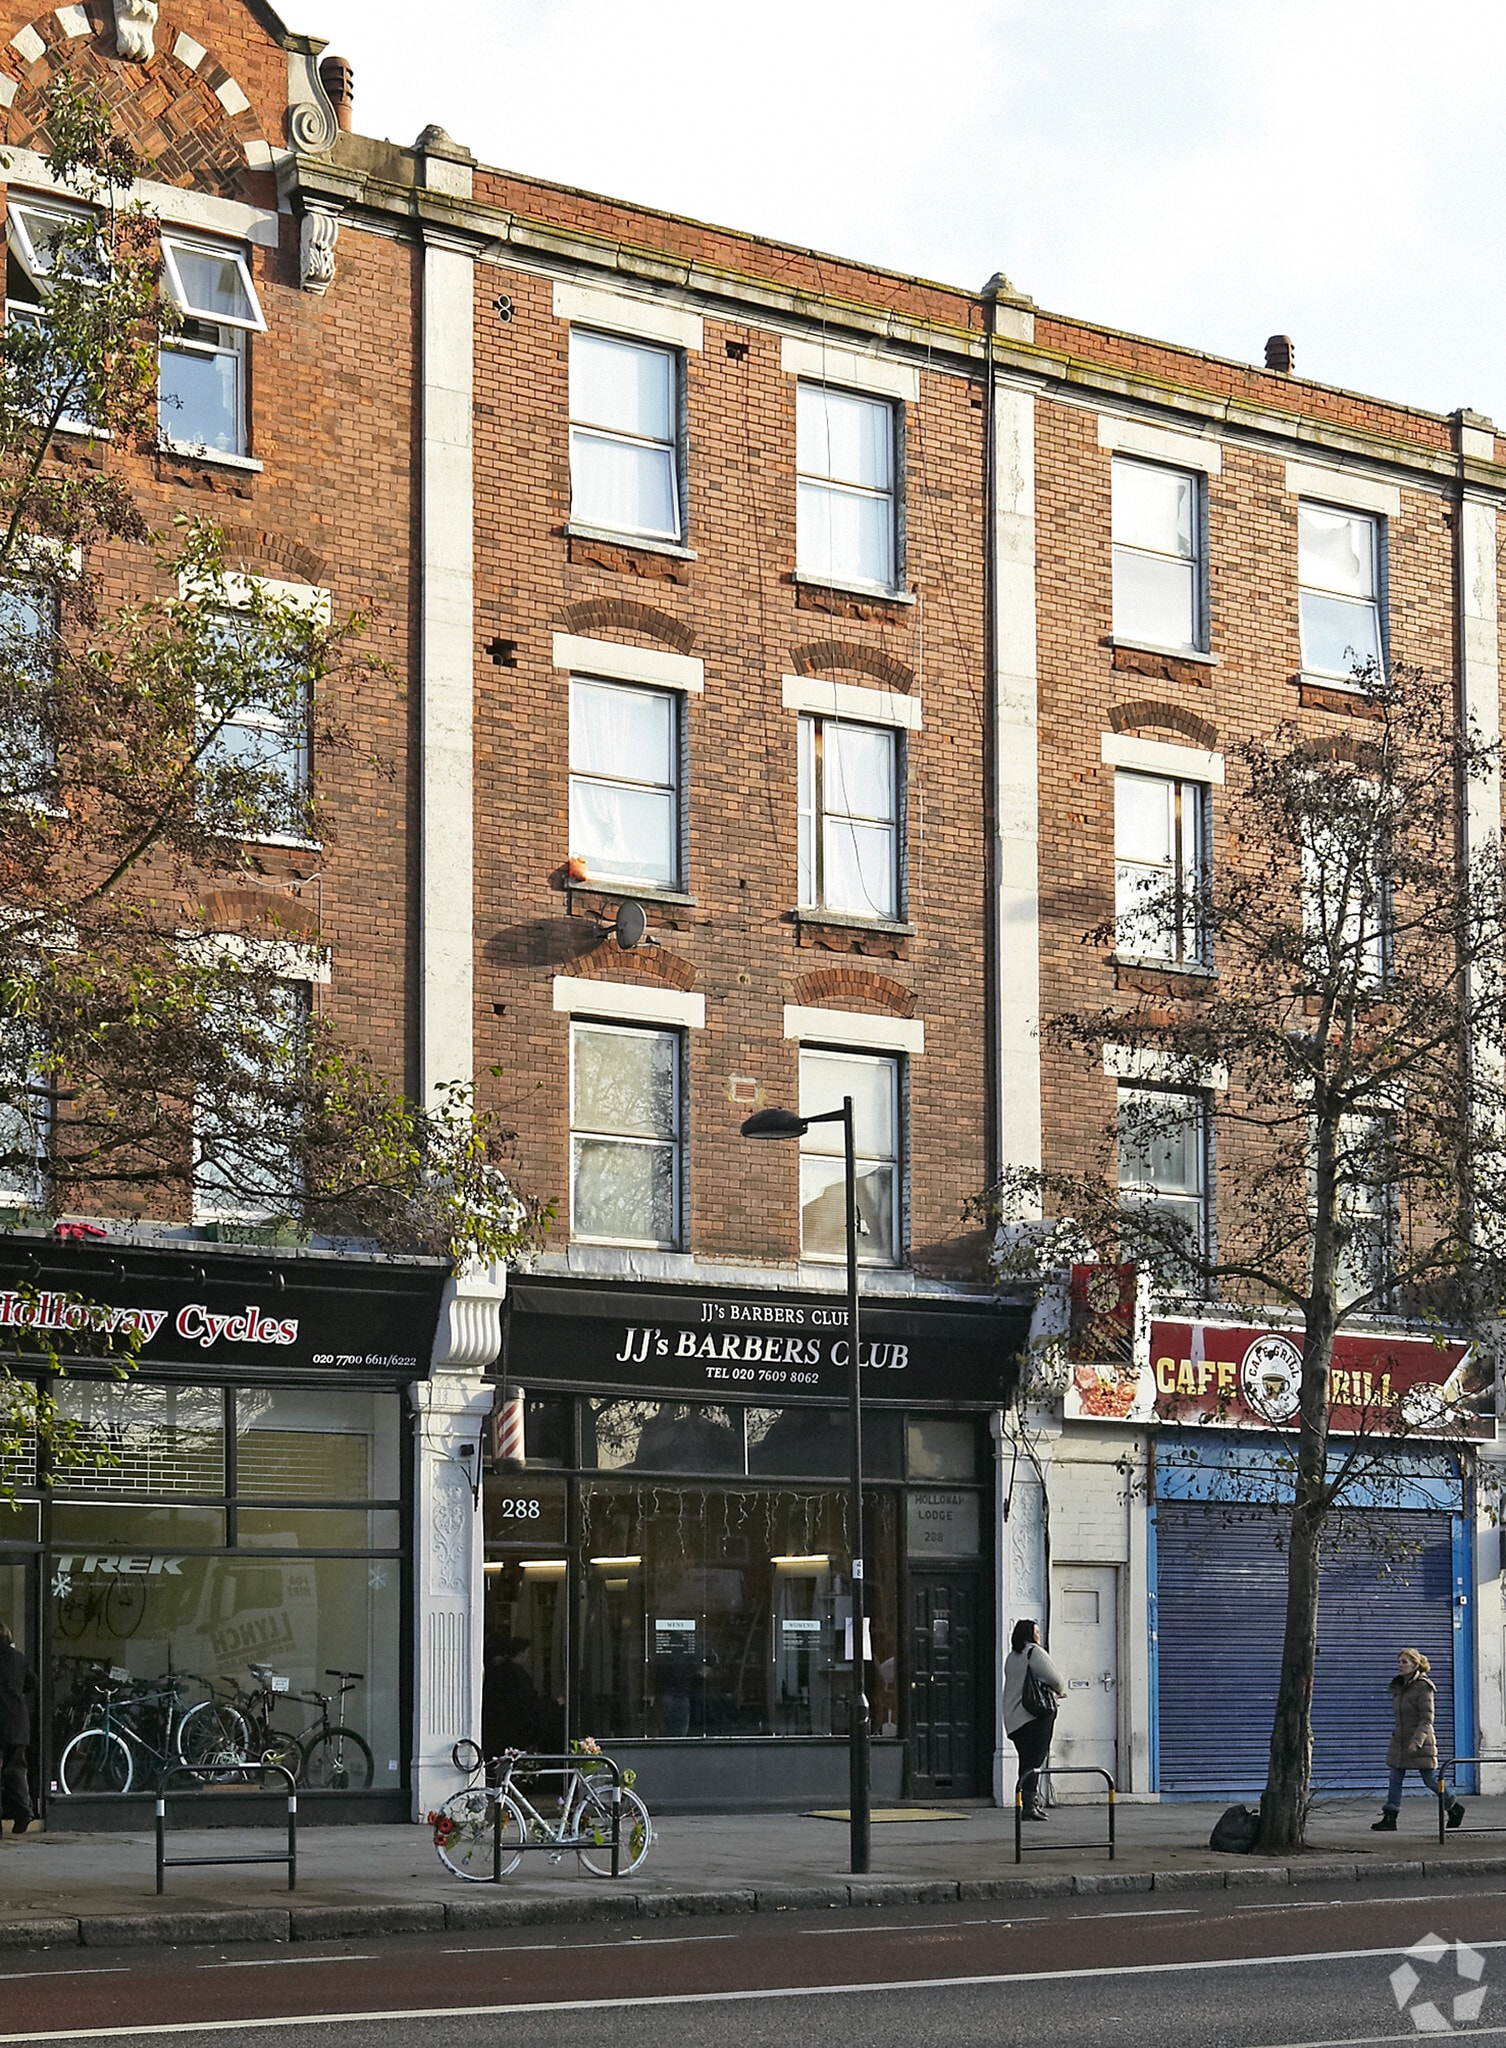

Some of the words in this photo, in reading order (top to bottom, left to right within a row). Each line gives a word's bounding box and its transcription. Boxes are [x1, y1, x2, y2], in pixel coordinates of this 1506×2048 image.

[700, 1303, 726, 1323] JJ's
[730, 1305, 805, 1324] BARBERS
[176, 1304, 299, 1348] Cycles
[615, 1327, 669, 1362] JJ's
[674, 1330, 821, 1365] BARBERS
[312, 1353, 335, 1365] 020
[336, 1354, 363, 1367] 7700
[365, 1353, 417, 1368] 6611/6222
[705, 1366, 730, 1379] TEL
[732, 1367, 755, 1380] 020
[758, 1369, 787, 1382] 7609
[790, 1371, 819, 1384] 8062
[1156, 1357, 1237, 1398] CAFE
[1328, 1369, 1399, 1408] RILL
[501, 1498, 541, 1519] 288
[918, 1510, 953, 1521] LODGE
[51, 1554, 184, 1575] TREK
